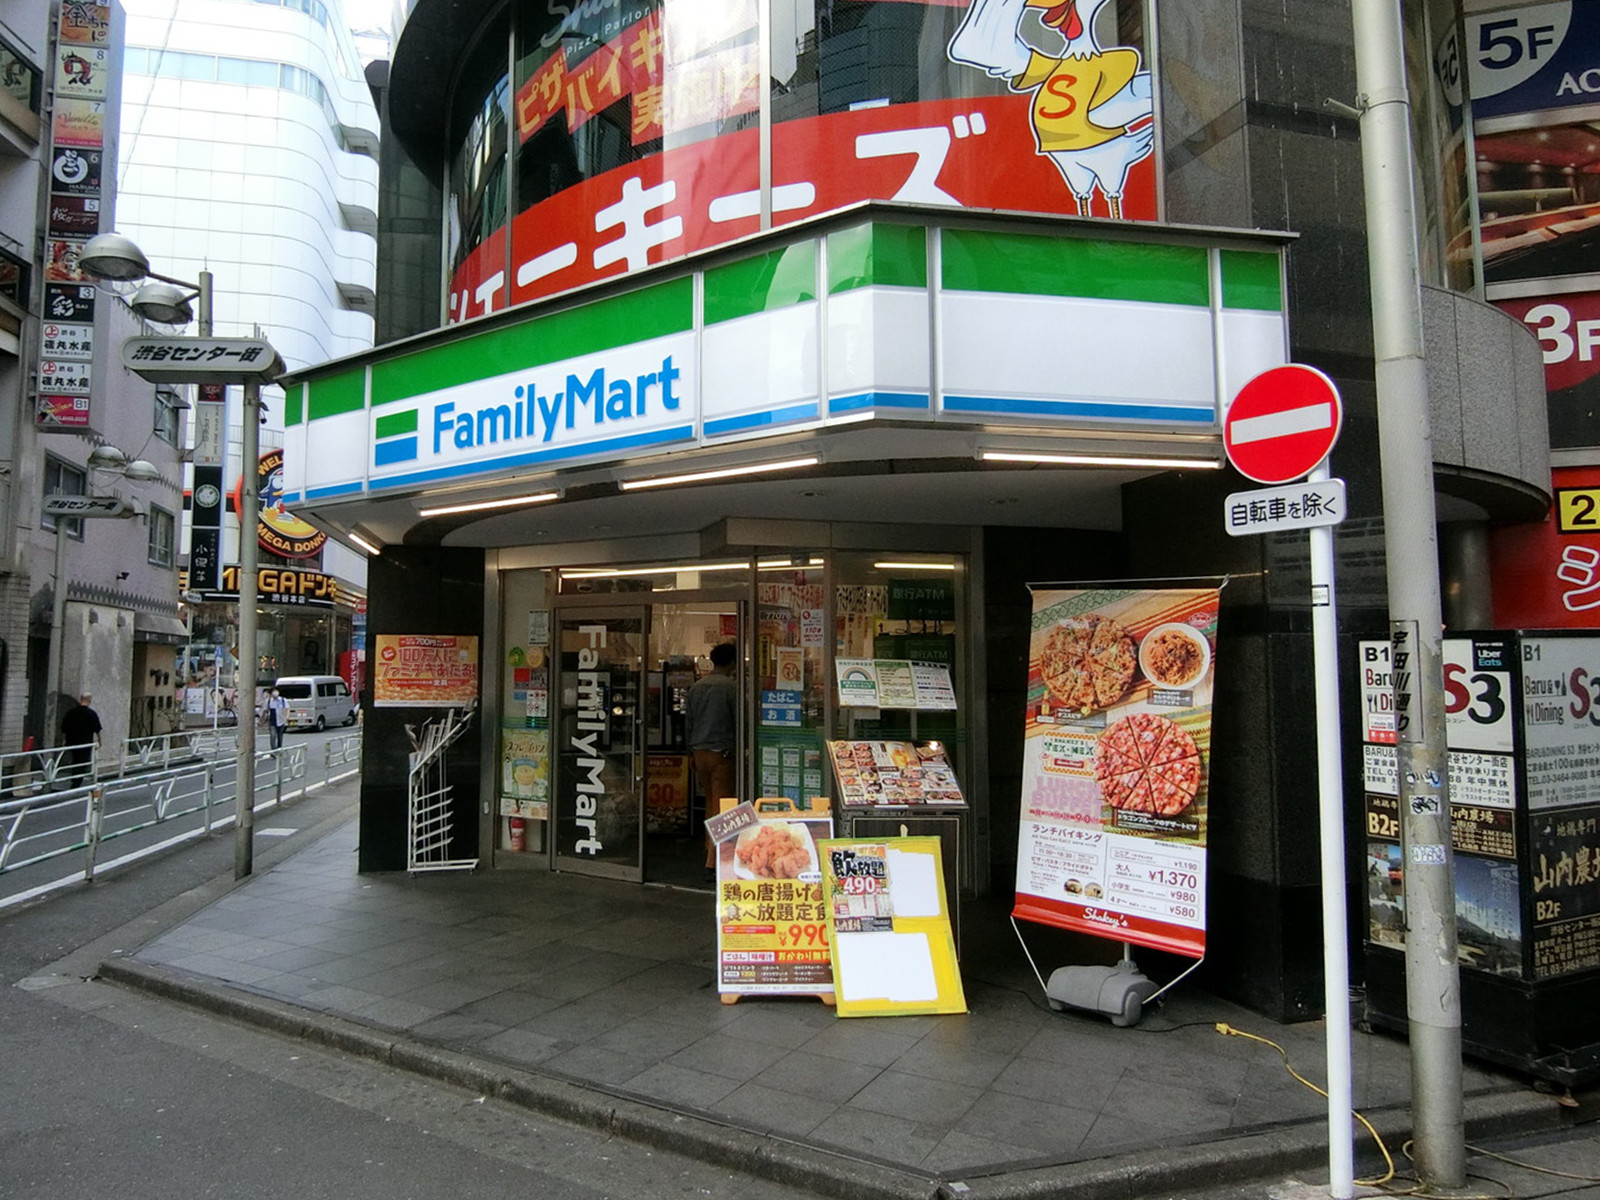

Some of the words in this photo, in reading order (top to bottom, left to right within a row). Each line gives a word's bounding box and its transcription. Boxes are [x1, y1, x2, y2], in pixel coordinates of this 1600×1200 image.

[566, 32, 599, 57] Pizza
[604, 6, 651, 35] Parlor
[1478, 18, 1554, 70] 5F
[1039, 75, 1077, 119] S
[88, 201, 95, 210] 5
[83, 287, 91, 297] 3
[1523, 304, 1600, 364] 3F
[131, 345, 264, 362] 渋谷センター街
[75, 400, 88, 409] B1
[433, 354, 680, 455] FamilyMart
[1231, 492, 1337, 527] 自転車を除く
[257, 522, 292, 552] MEGA
[271, 593, 305, 604] 渋谷本店
[1365, 647, 1389, 662] B1
[1477, 649, 1502, 658] Uber
[1478, 658, 1502, 667] Eats
[1523, 645, 1541, 661] B1
[1393, 631, 1412, 732] 宇田川通り
[767, 692, 795, 703] たばこ
[1535, 702, 1565, 726] Dining
[571, 625, 607, 855] FamilyMart
[1032, 823, 1103, 843] ランチバイキング
[1368, 812, 1399, 837] B2F
[1115, 863, 1131, 873] 大人
[723, 882, 811, 902] 鶏の唐揚げ
[844, 876, 876, 894] 490
[1111, 881, 1131, 891] 小学生
[1170, 890, 1196, 903] ¥980
[1082, 906, 1129, 929] Shakey's
[1170, 905, 1195, 918] ¥580
[1536, 899, 1561, 921] B2F
